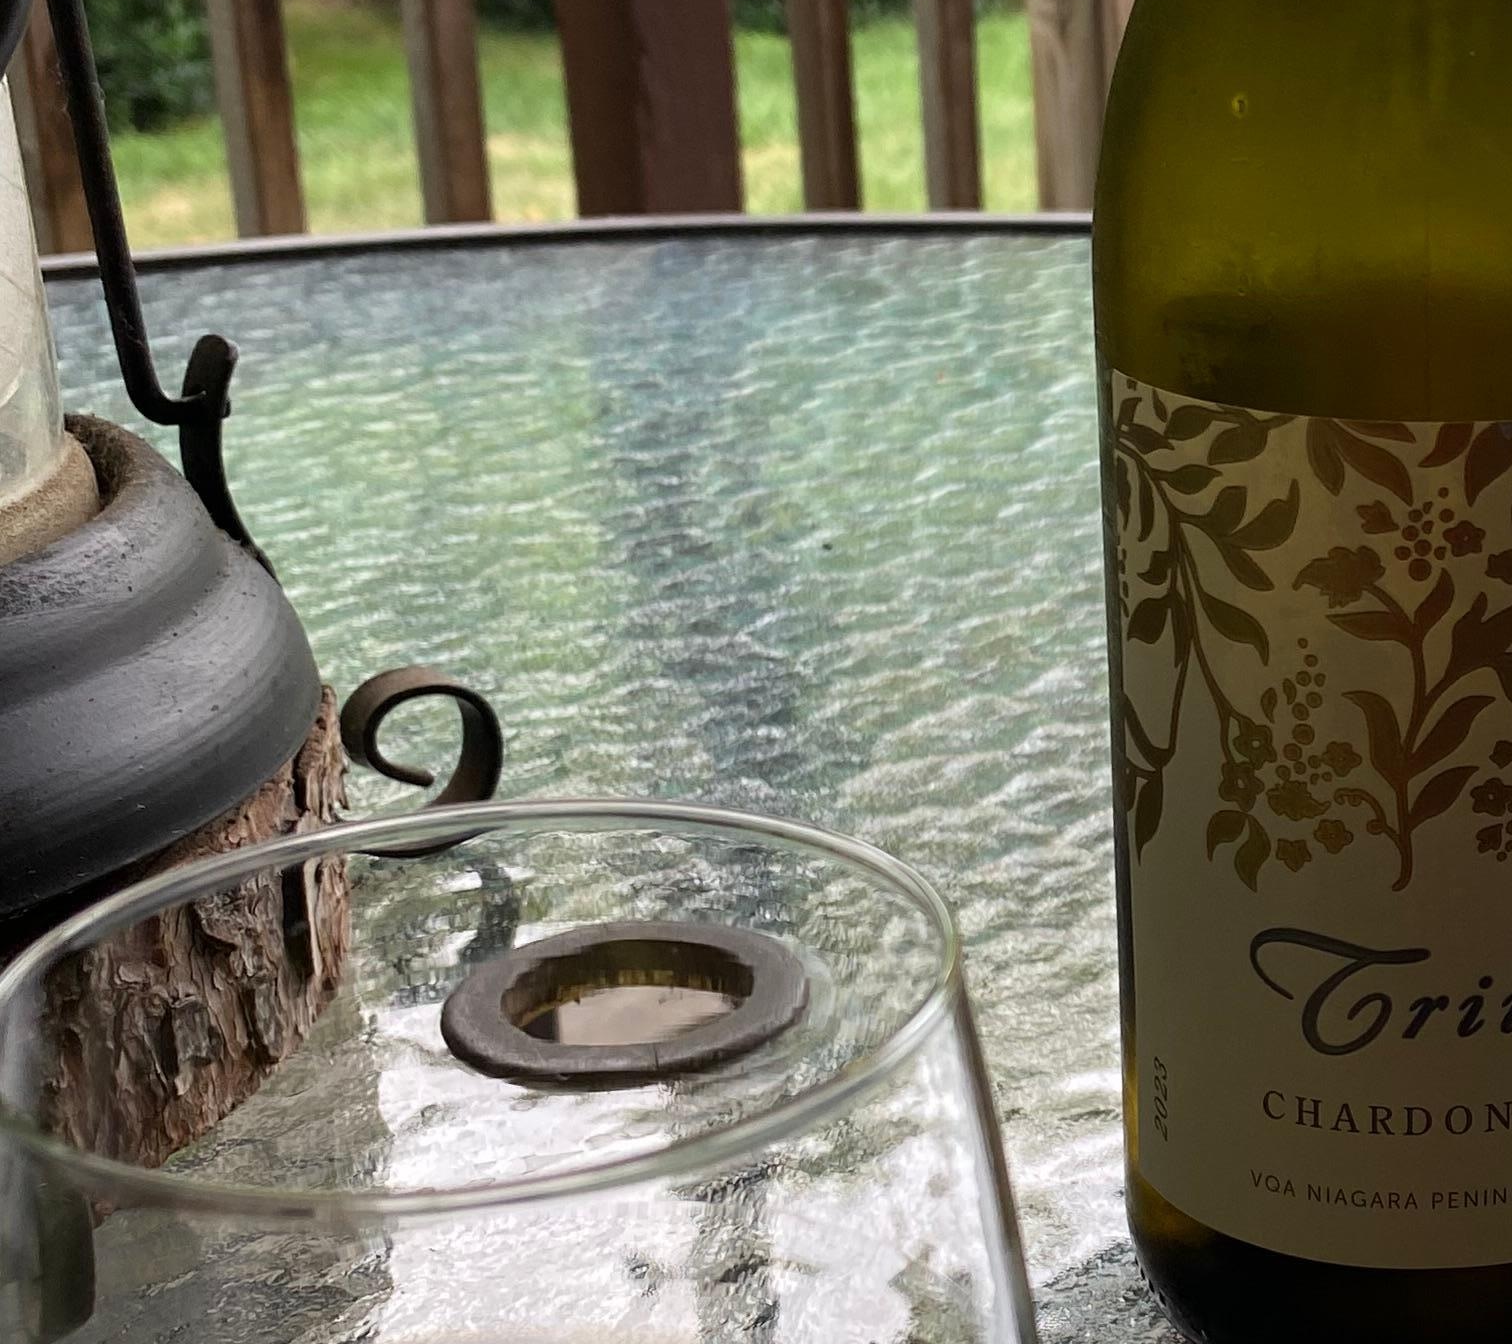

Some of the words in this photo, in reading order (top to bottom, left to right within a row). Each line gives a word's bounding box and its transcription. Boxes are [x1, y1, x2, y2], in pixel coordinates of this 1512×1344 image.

[1153, 1055, 1168, 1142] 2023
[1250, 1168, 1296, 1198] VQA
[1306, 1183, 1419, 1210] NIAGARA
